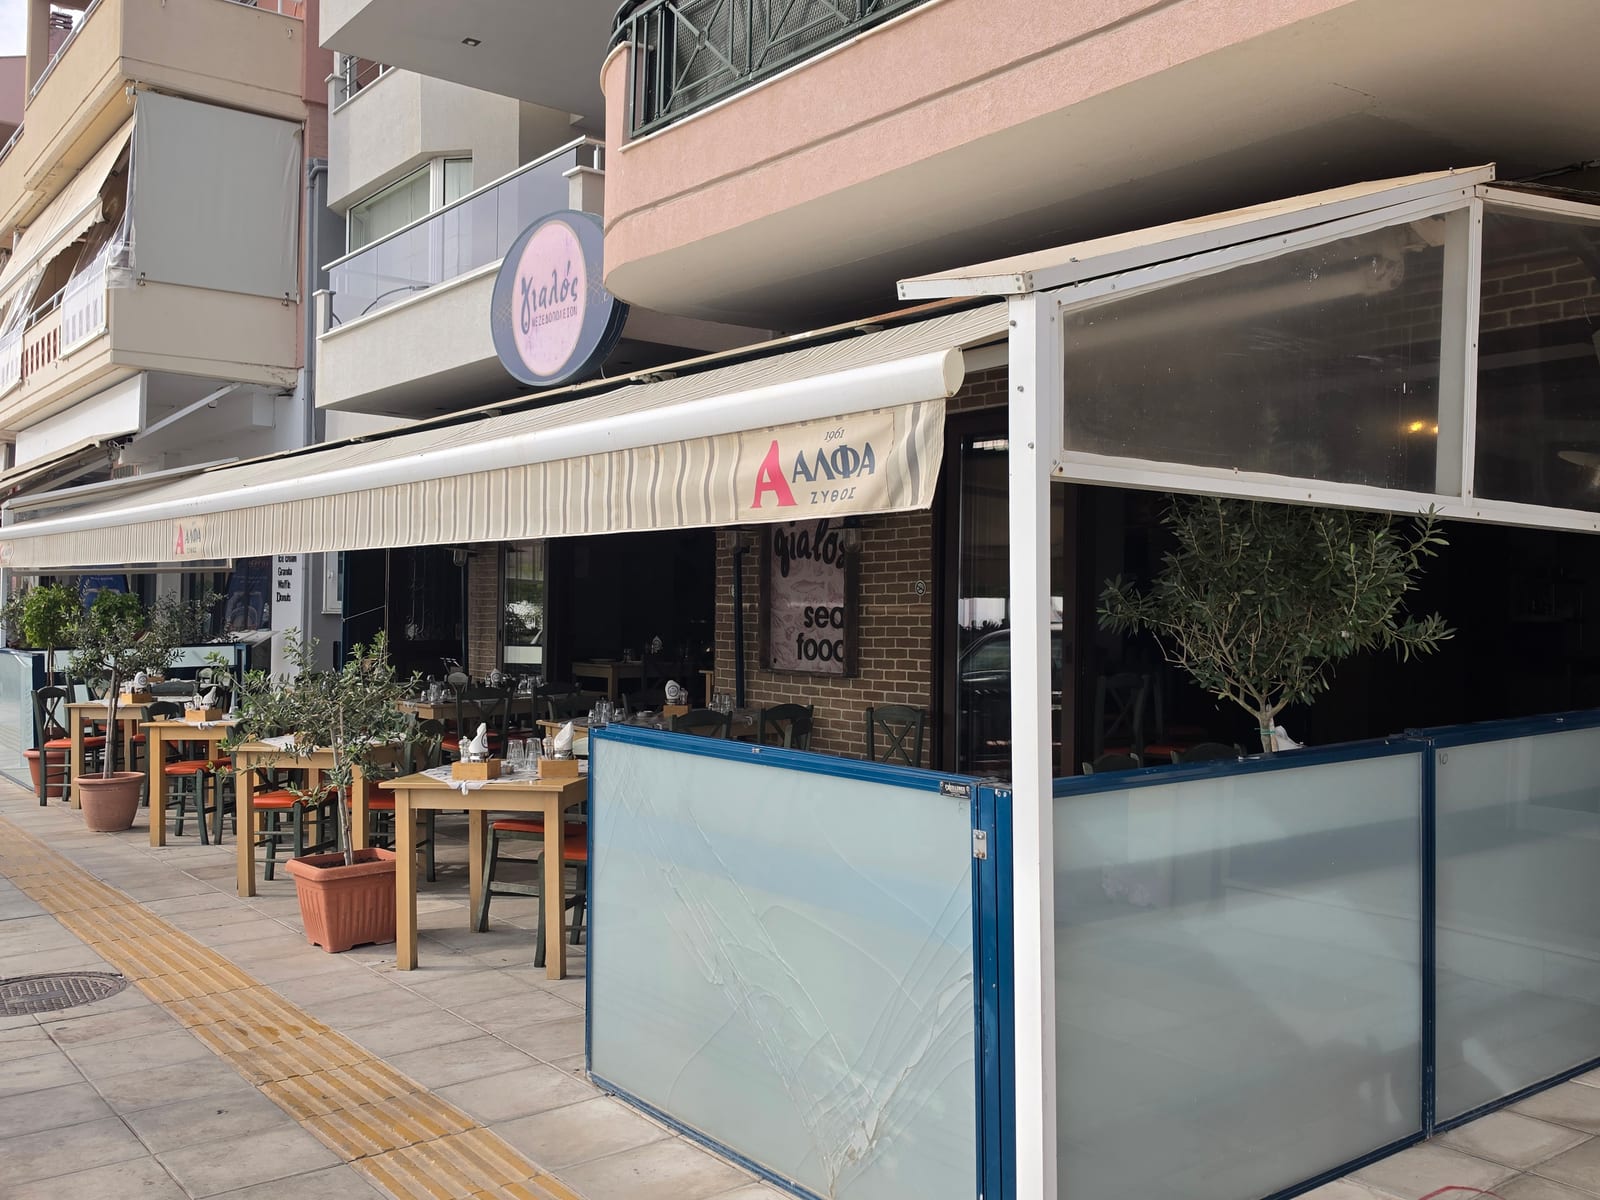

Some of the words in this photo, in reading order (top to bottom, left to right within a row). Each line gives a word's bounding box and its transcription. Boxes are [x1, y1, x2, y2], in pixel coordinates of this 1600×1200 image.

[521, 260, 578, 335] γιαλός
[824, 427, 845, 441] 1961
[792, 441, 876, 483] ΑΛΦΑ
[810, 486, 857, 505] ΖΥΘΟΣ
